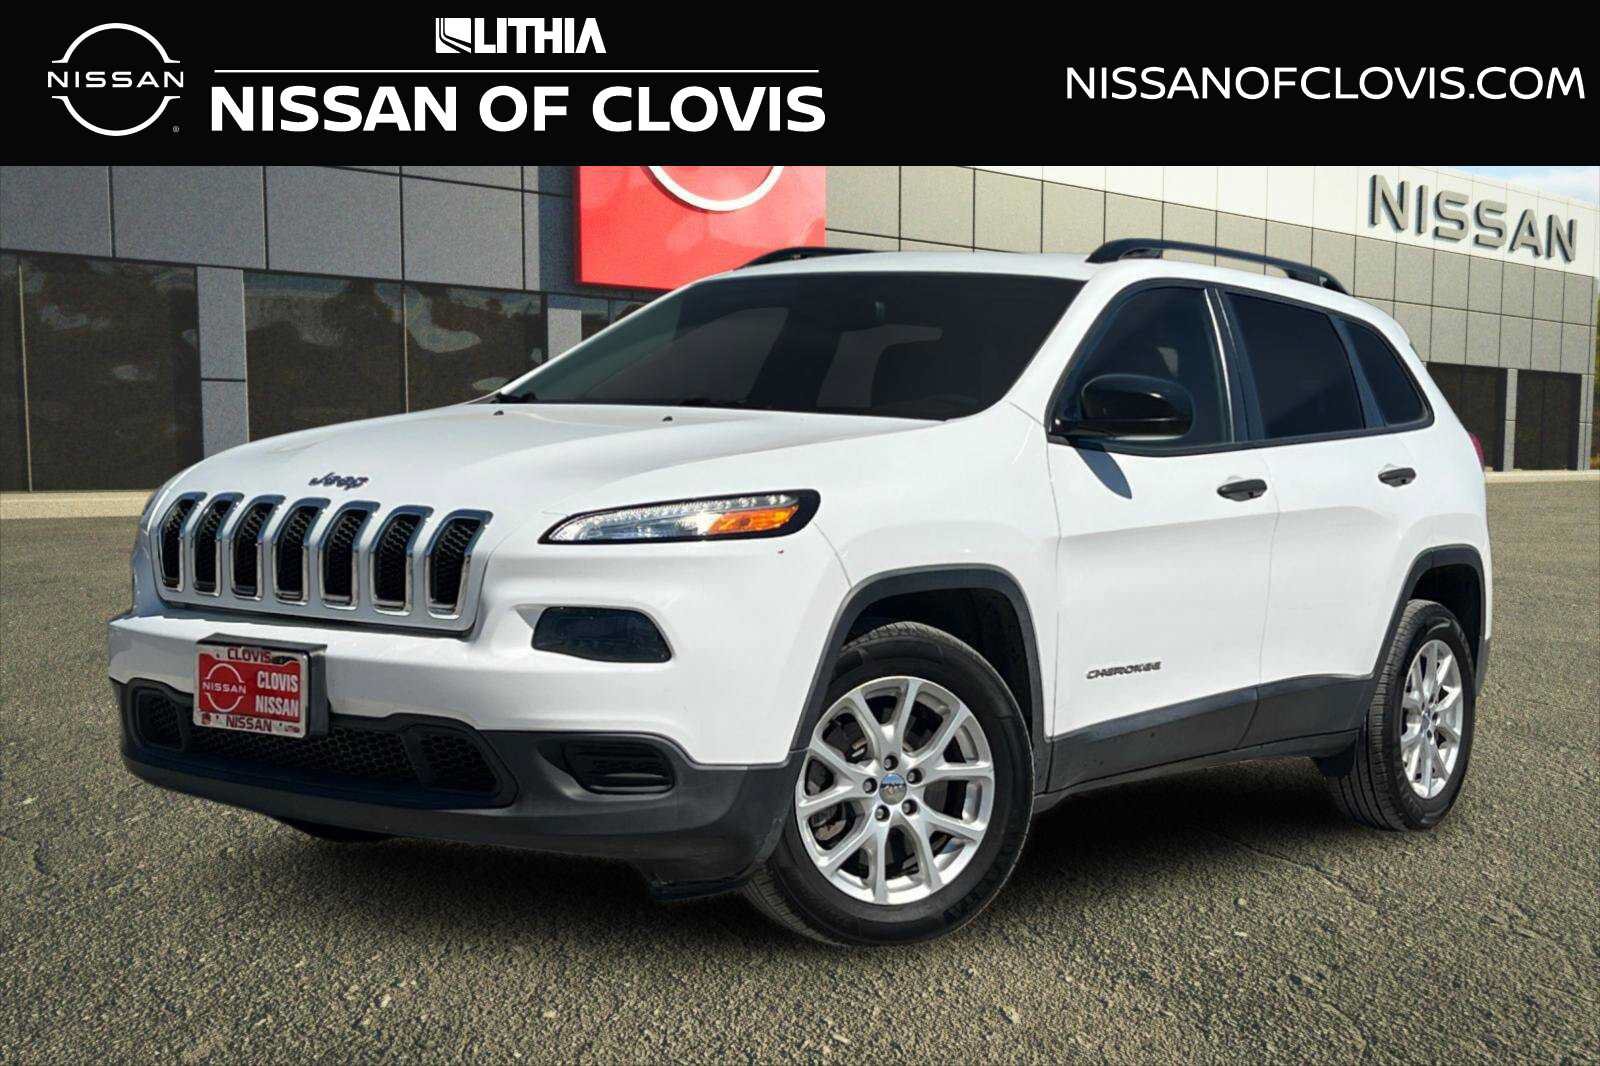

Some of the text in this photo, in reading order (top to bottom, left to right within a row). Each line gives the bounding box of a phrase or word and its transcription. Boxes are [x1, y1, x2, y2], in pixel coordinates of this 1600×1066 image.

[1369, 174, 1578, 262] NISSAN
[308, 472, 369, 490] Jeep
[227, 648, 271, 662] CLOVIS
[1087, 661, 1162, 679] CHEROKEE
[202, 681, 246, 694] NISSAN
[257, 670, 298, 693] CLOVIS
[255, 694, 299, 718] NISSAN
[225, 714, 272, 732] NISSAN
